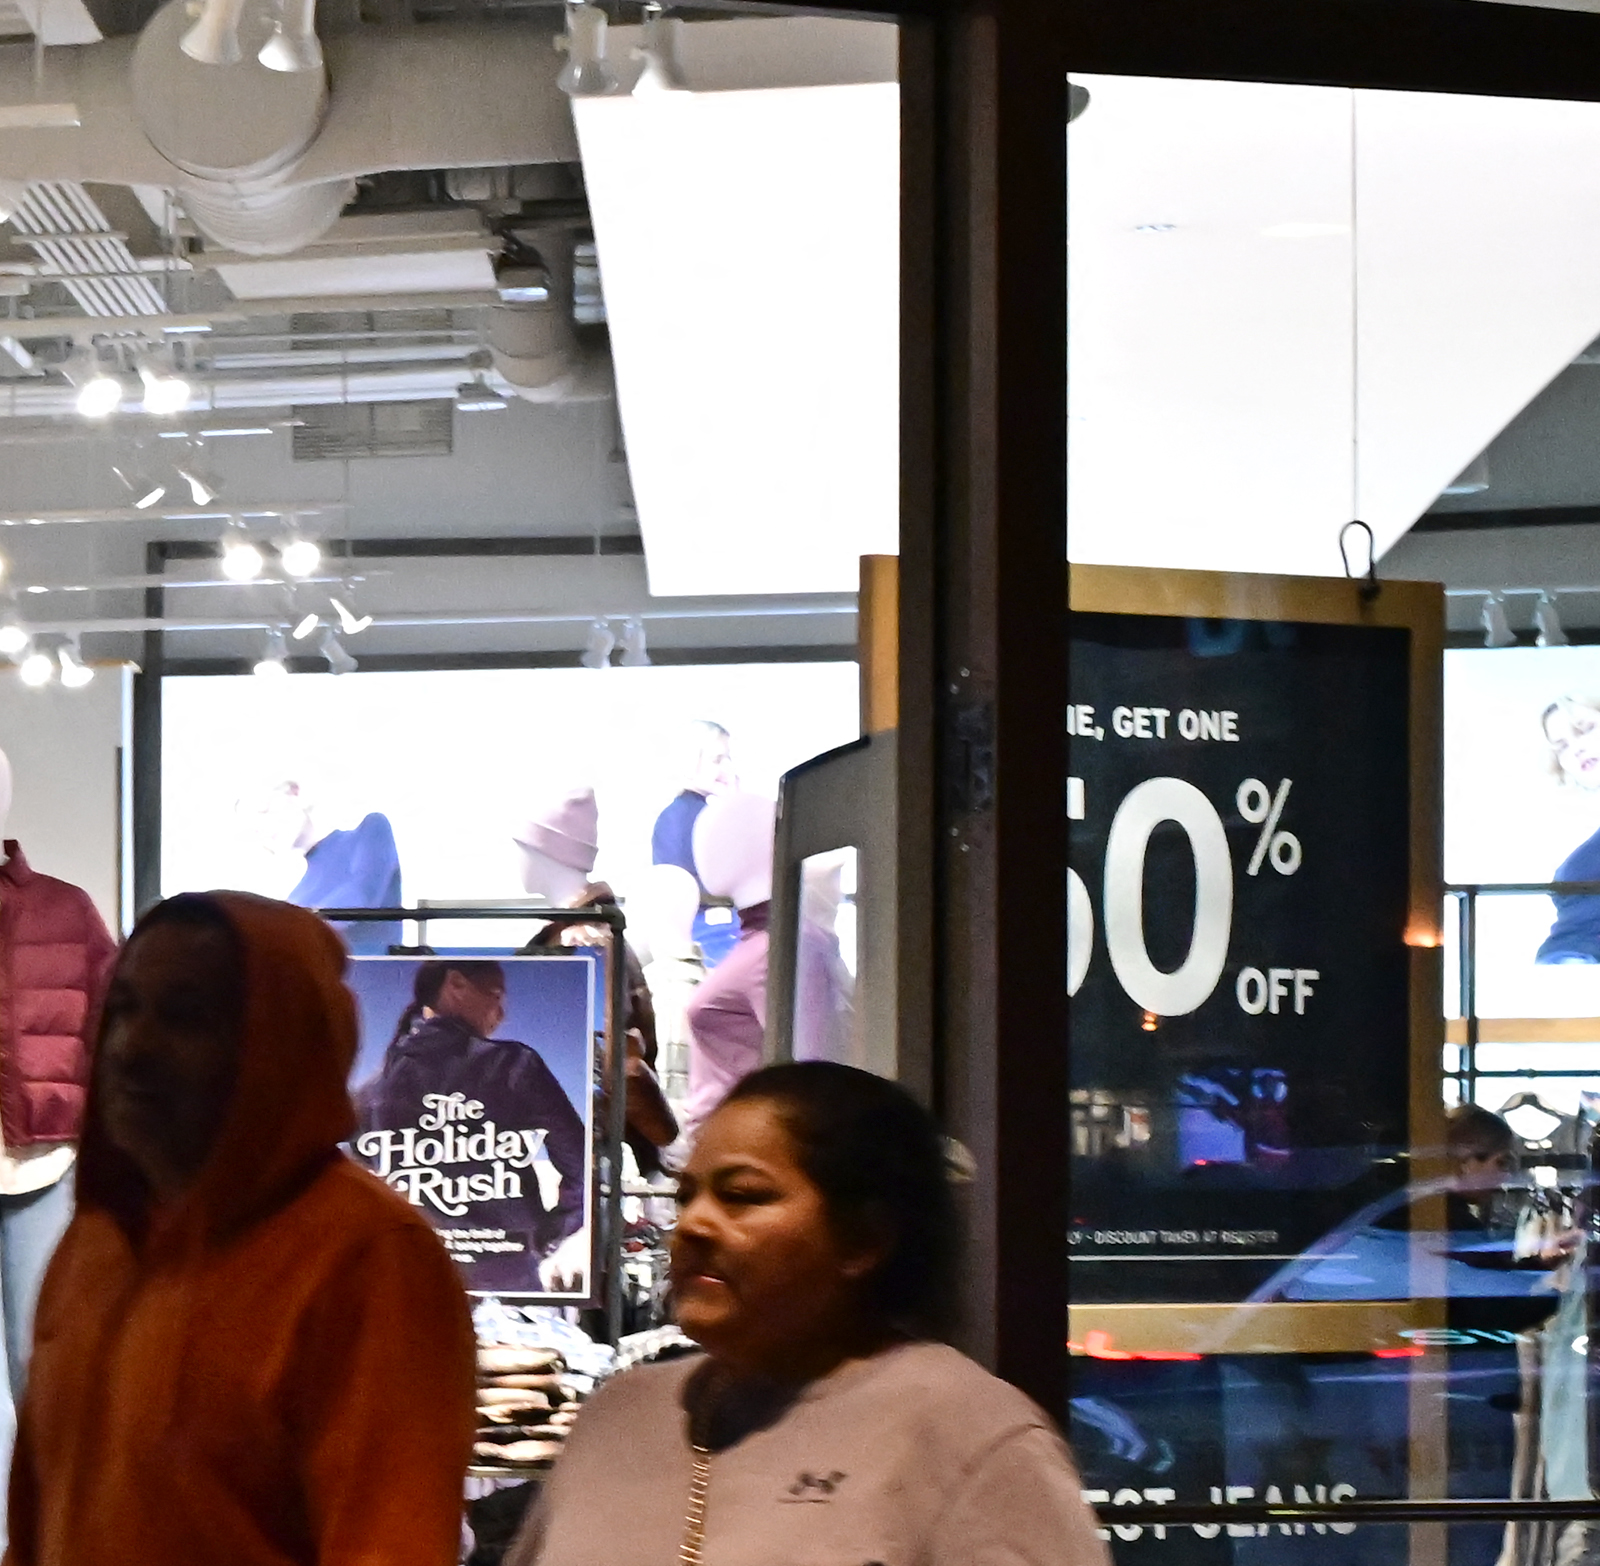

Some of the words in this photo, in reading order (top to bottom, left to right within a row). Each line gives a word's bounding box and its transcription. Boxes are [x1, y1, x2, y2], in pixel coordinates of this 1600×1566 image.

[1111, 706, 1171, 740] GET
[1178, 710, 1240, 742] ONE
[1236, 967, 1321, 1015] OFF
[418, 1092, 486, 1131] The
[356, 1121, 550, 1179] Holiday
[385, 1160, 524, 1216] Rush
[1192, 1483, 1358, 1538] JEANS
